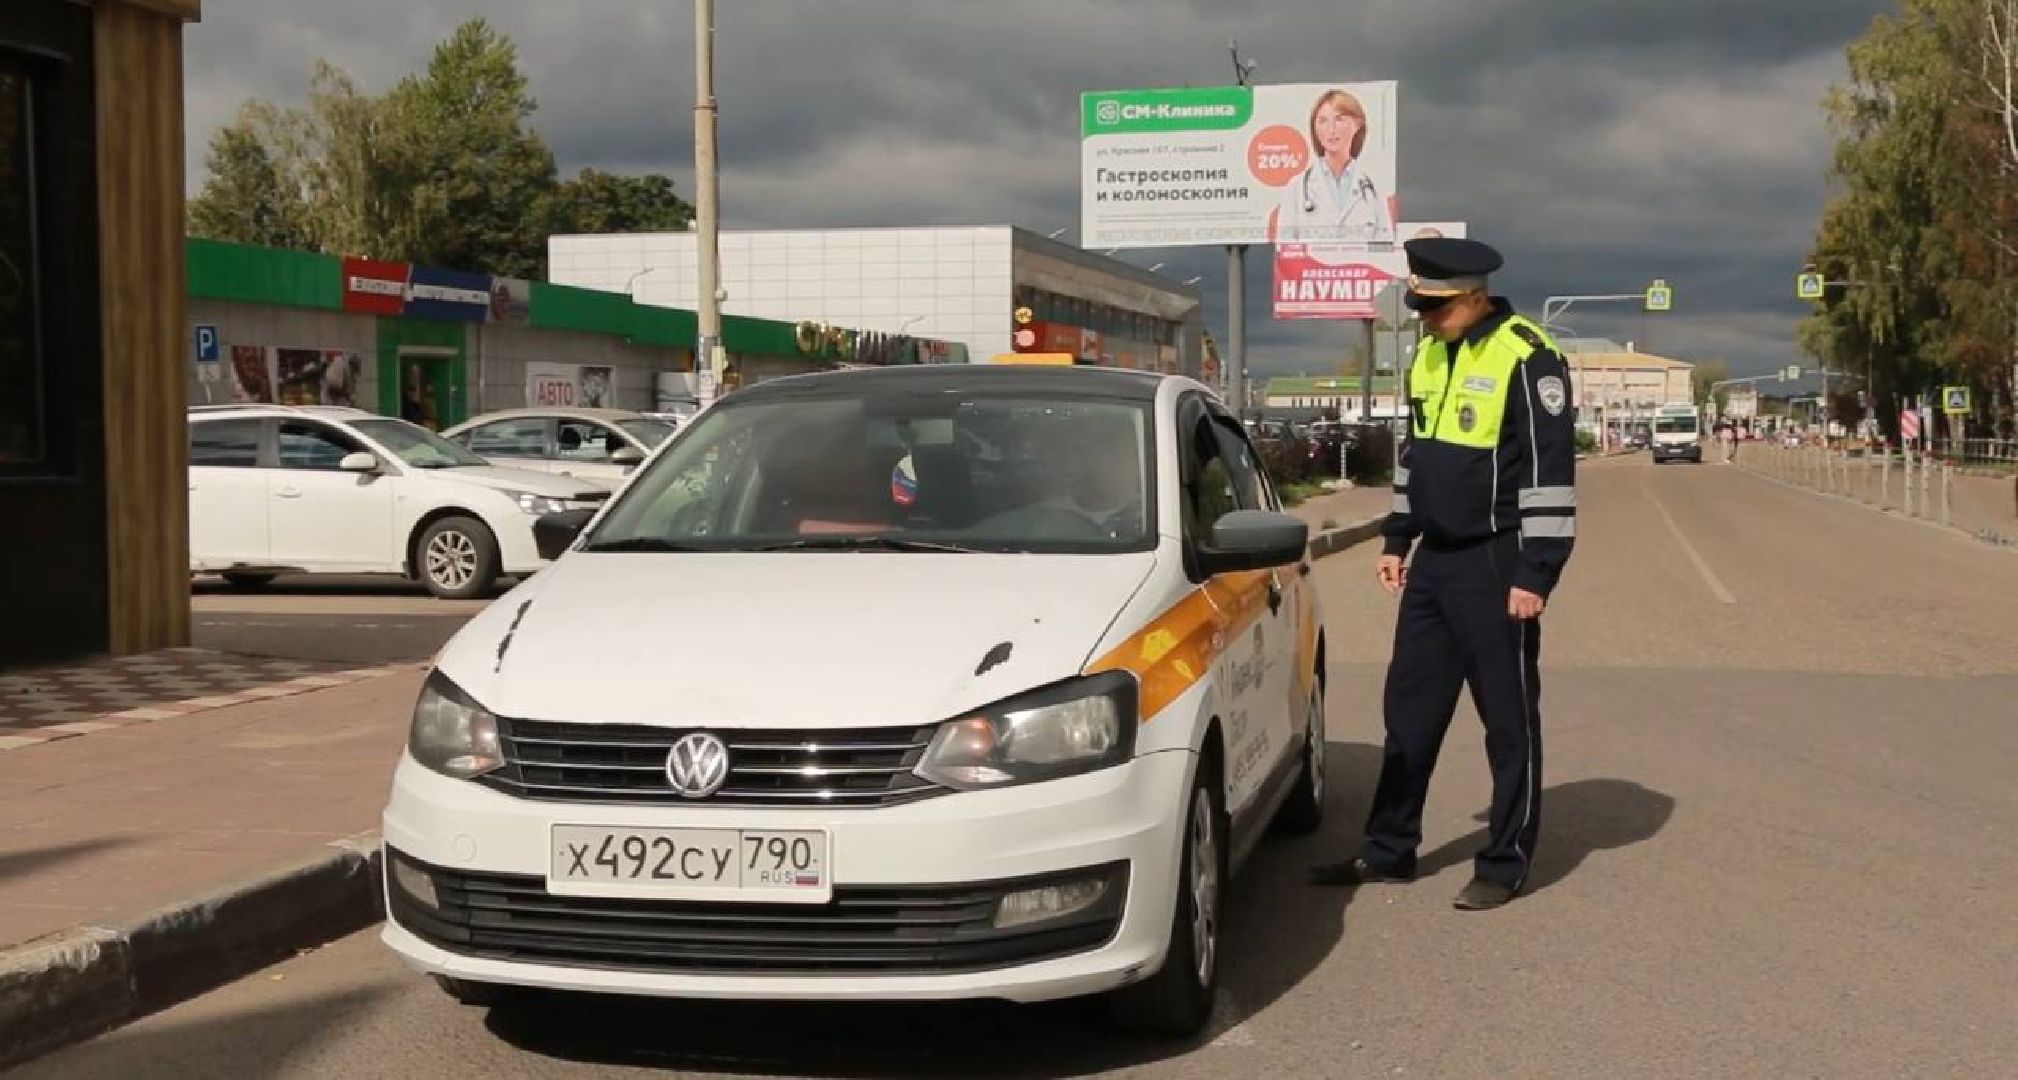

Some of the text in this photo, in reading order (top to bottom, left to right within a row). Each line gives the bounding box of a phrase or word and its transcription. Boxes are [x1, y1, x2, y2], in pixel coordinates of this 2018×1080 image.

[1122, 103, 1236, 119] СМ-Клиника
[1097, 168, 1229, 186] Гастроскопия
[1097, 187, 1249, 201] и колоноскопия
[539, 381, 574, 406] АВТО
[744, 837, 811, 871] 790
[760, 870, 793, 884] RUS
